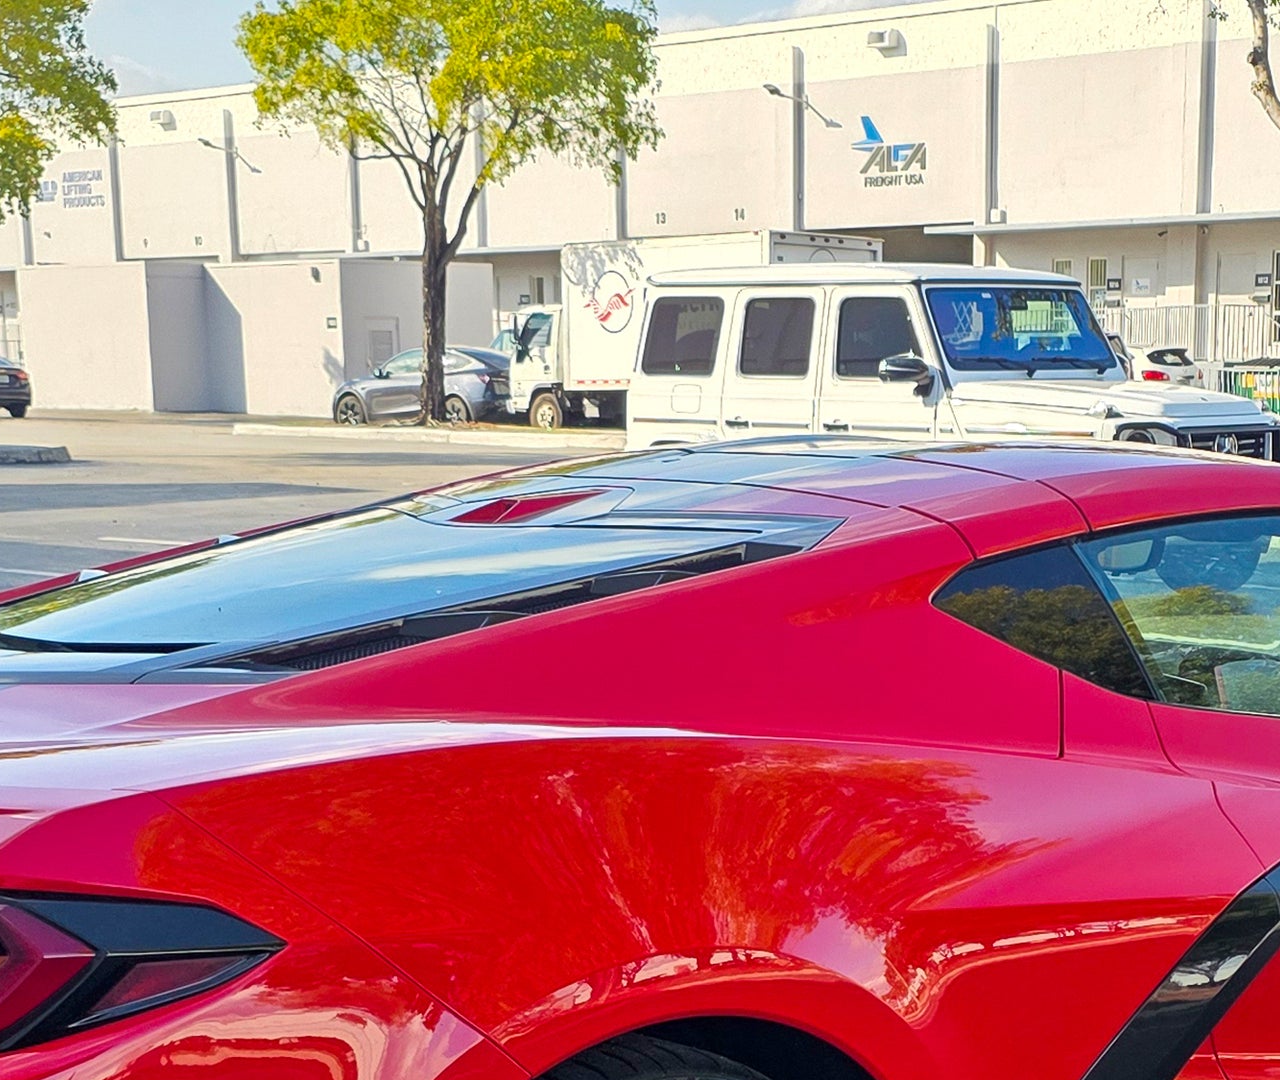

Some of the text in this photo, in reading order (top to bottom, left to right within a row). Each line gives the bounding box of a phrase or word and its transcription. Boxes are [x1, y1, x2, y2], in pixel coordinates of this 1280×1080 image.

[859, 142, 927, 174] ALFA
[62, 169, 103, 183] AMERICAN
[864, 173, 924, 188] FREIGHT USA
[62, 183, 92, 196] LIFTING
[63, 195, 106, 208] PRODUCTS
[655, 212, 666, 225] 13
[734, 208, 745, 221] 14
